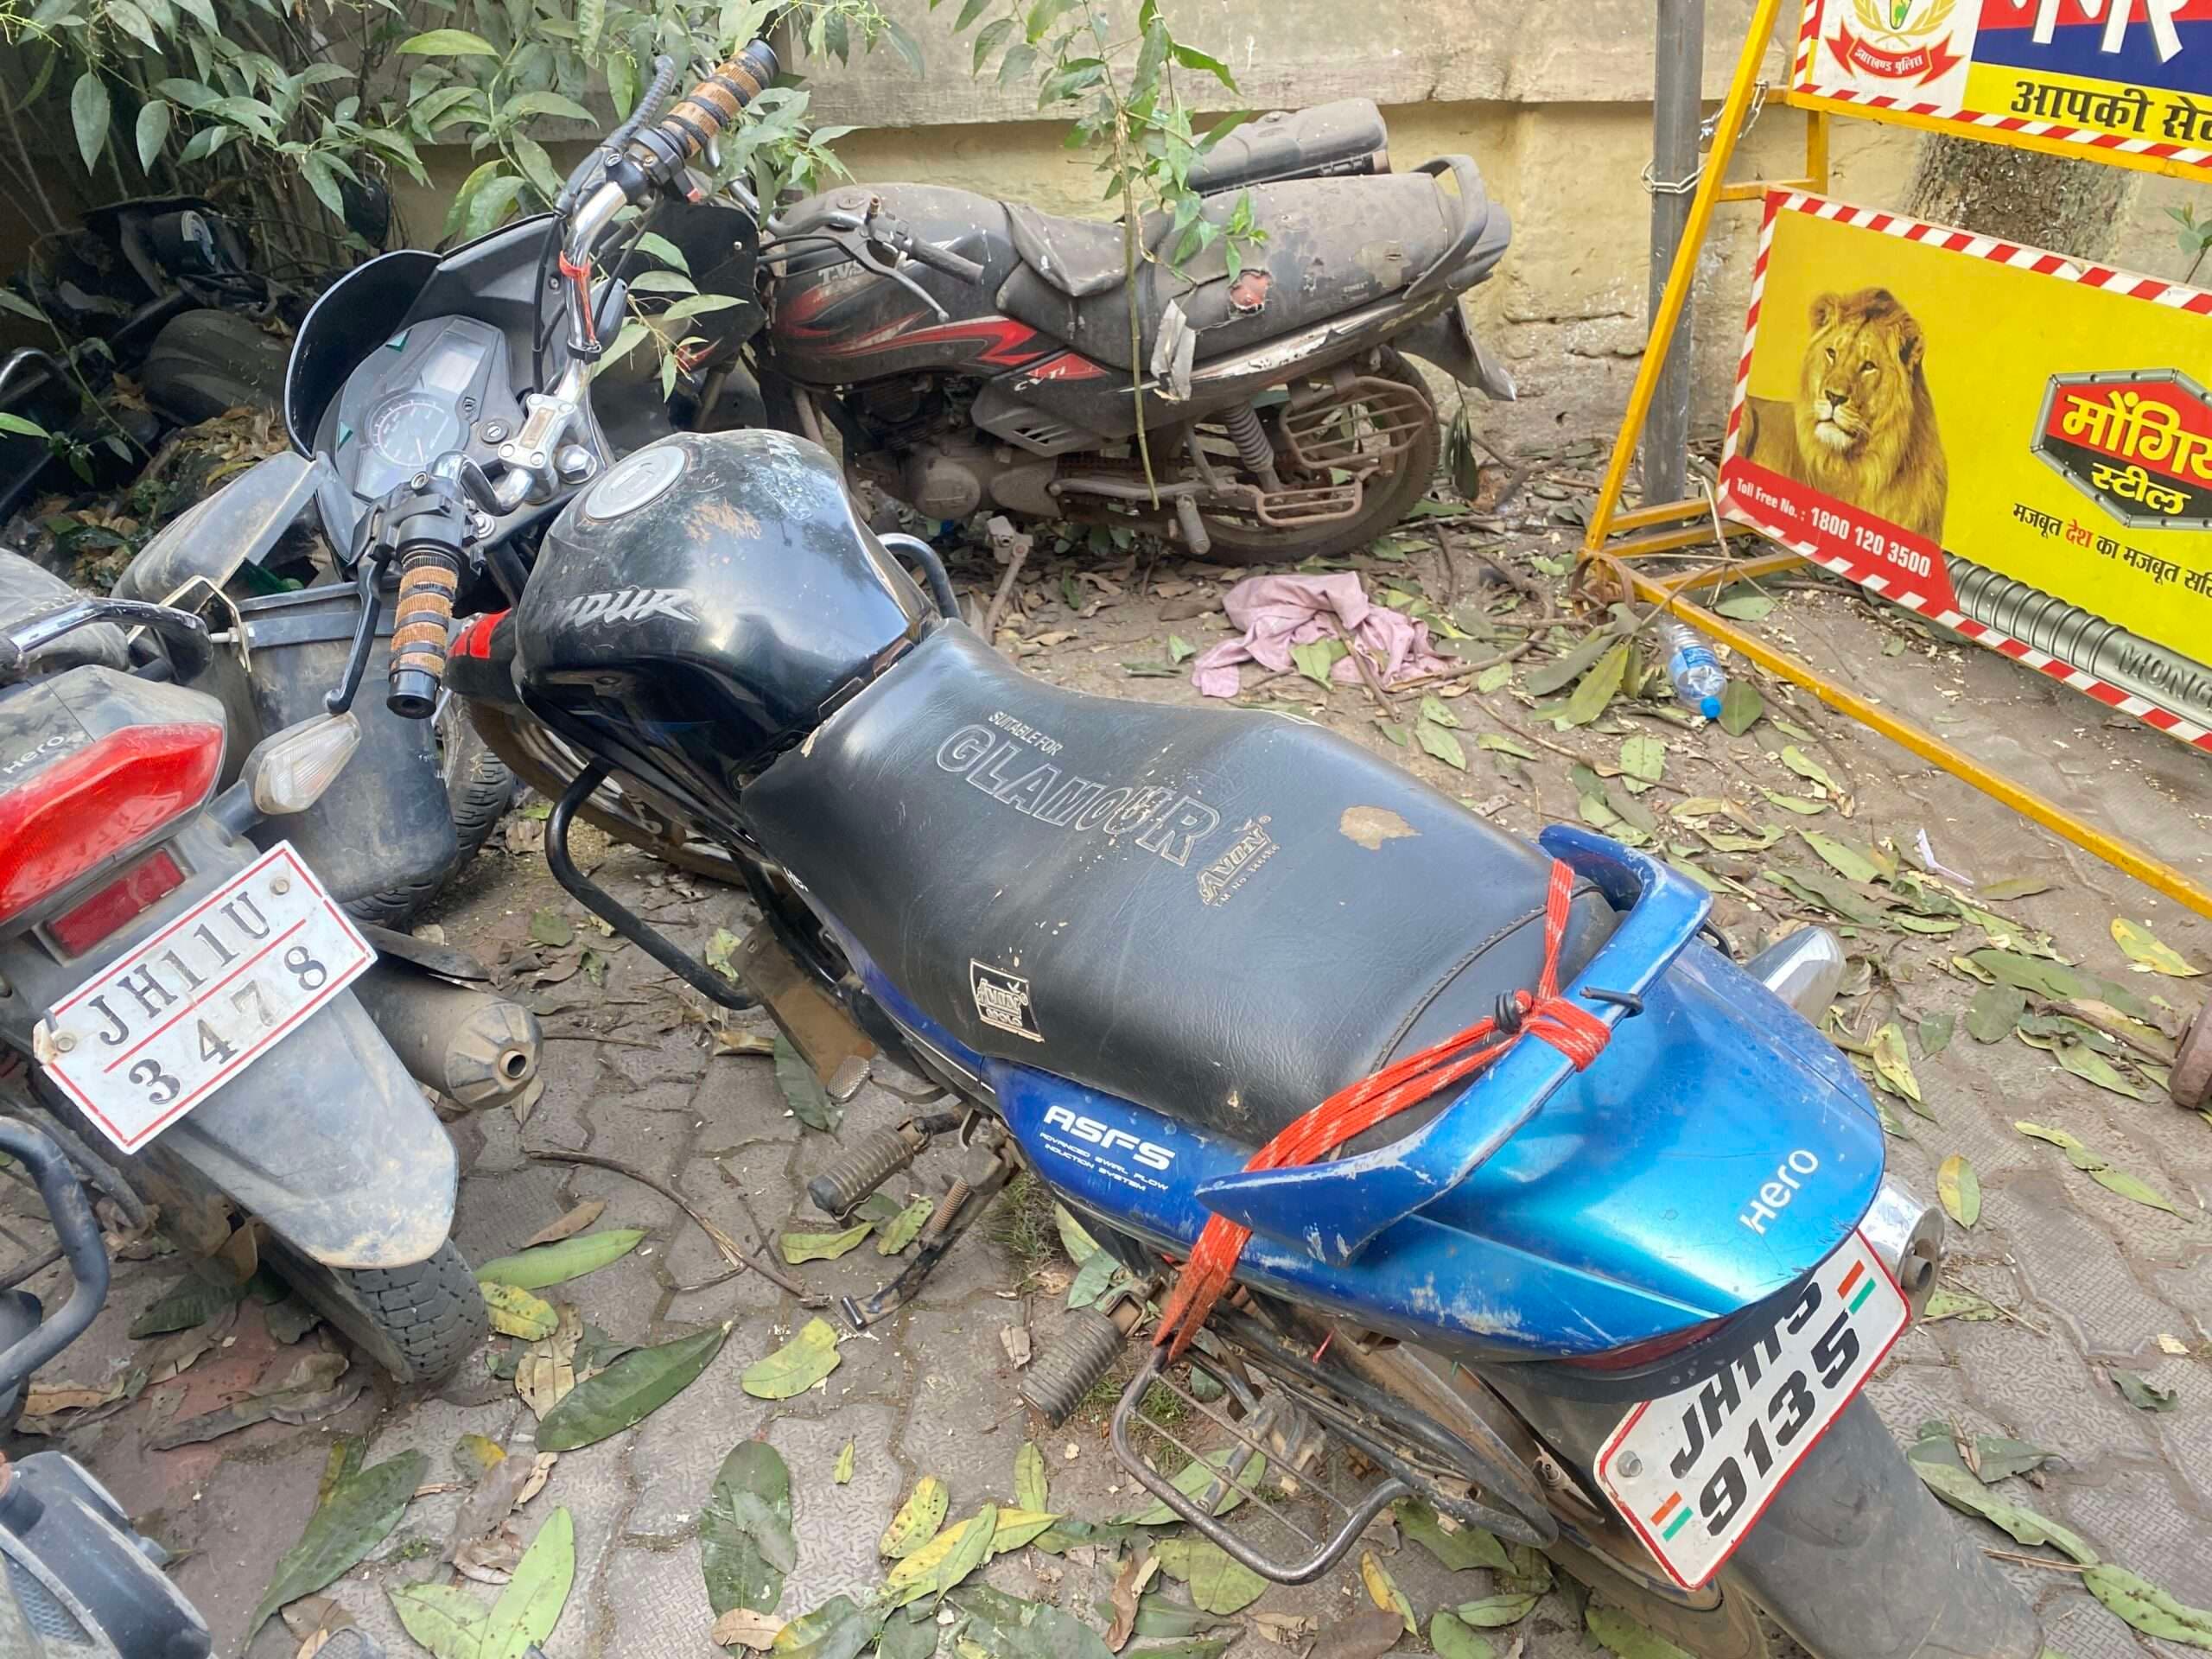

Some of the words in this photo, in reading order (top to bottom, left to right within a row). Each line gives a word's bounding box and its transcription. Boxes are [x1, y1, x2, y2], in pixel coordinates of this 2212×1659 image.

[2011, 80, 2154, 132] आपकी
[2091, 462, 2192, 514] स्टील
[1737, 478, 1753, 498] Toll
[1756, 486, 1777, 508] Free
[1811, 507, 1850, 540] 1800
[1854, 526, 1884, 556] 120
[1887, 542, 1931, 578] 3500
[2013, 503, 2063, 539] मजबूत
[2065, 518, 2094, 549] देश
[2096, 536, 2120, 559] का
[2123, 546, 2181, 585] मजबूत
[3, 736, 65, 774] Hero
[988, 711, 1042, 744] SUITABLE
[1033, 735, 1064, 756] FOR
[936, 724, 1221, 867] GLAMOUR
[88, 891, 270, 1046] JH11U
[129, 945, 327, 1105] 3478
[1039, 1132, 1090, 1158] ADVANCED
[1095, 1156, 1129, 1175] SWIRL
[1133, 1173, 1169, 1191] FLOW
[1043, 1105, 1176, 1171] ASFS
[1045, 1143, 1095, 1169] INDUCTION
[1098, 1167, 1147, 1192] SYSTEM
[1739, 1148, 1820, 1236] Hero
[1700, 1310, 1861, 1537] 9135
